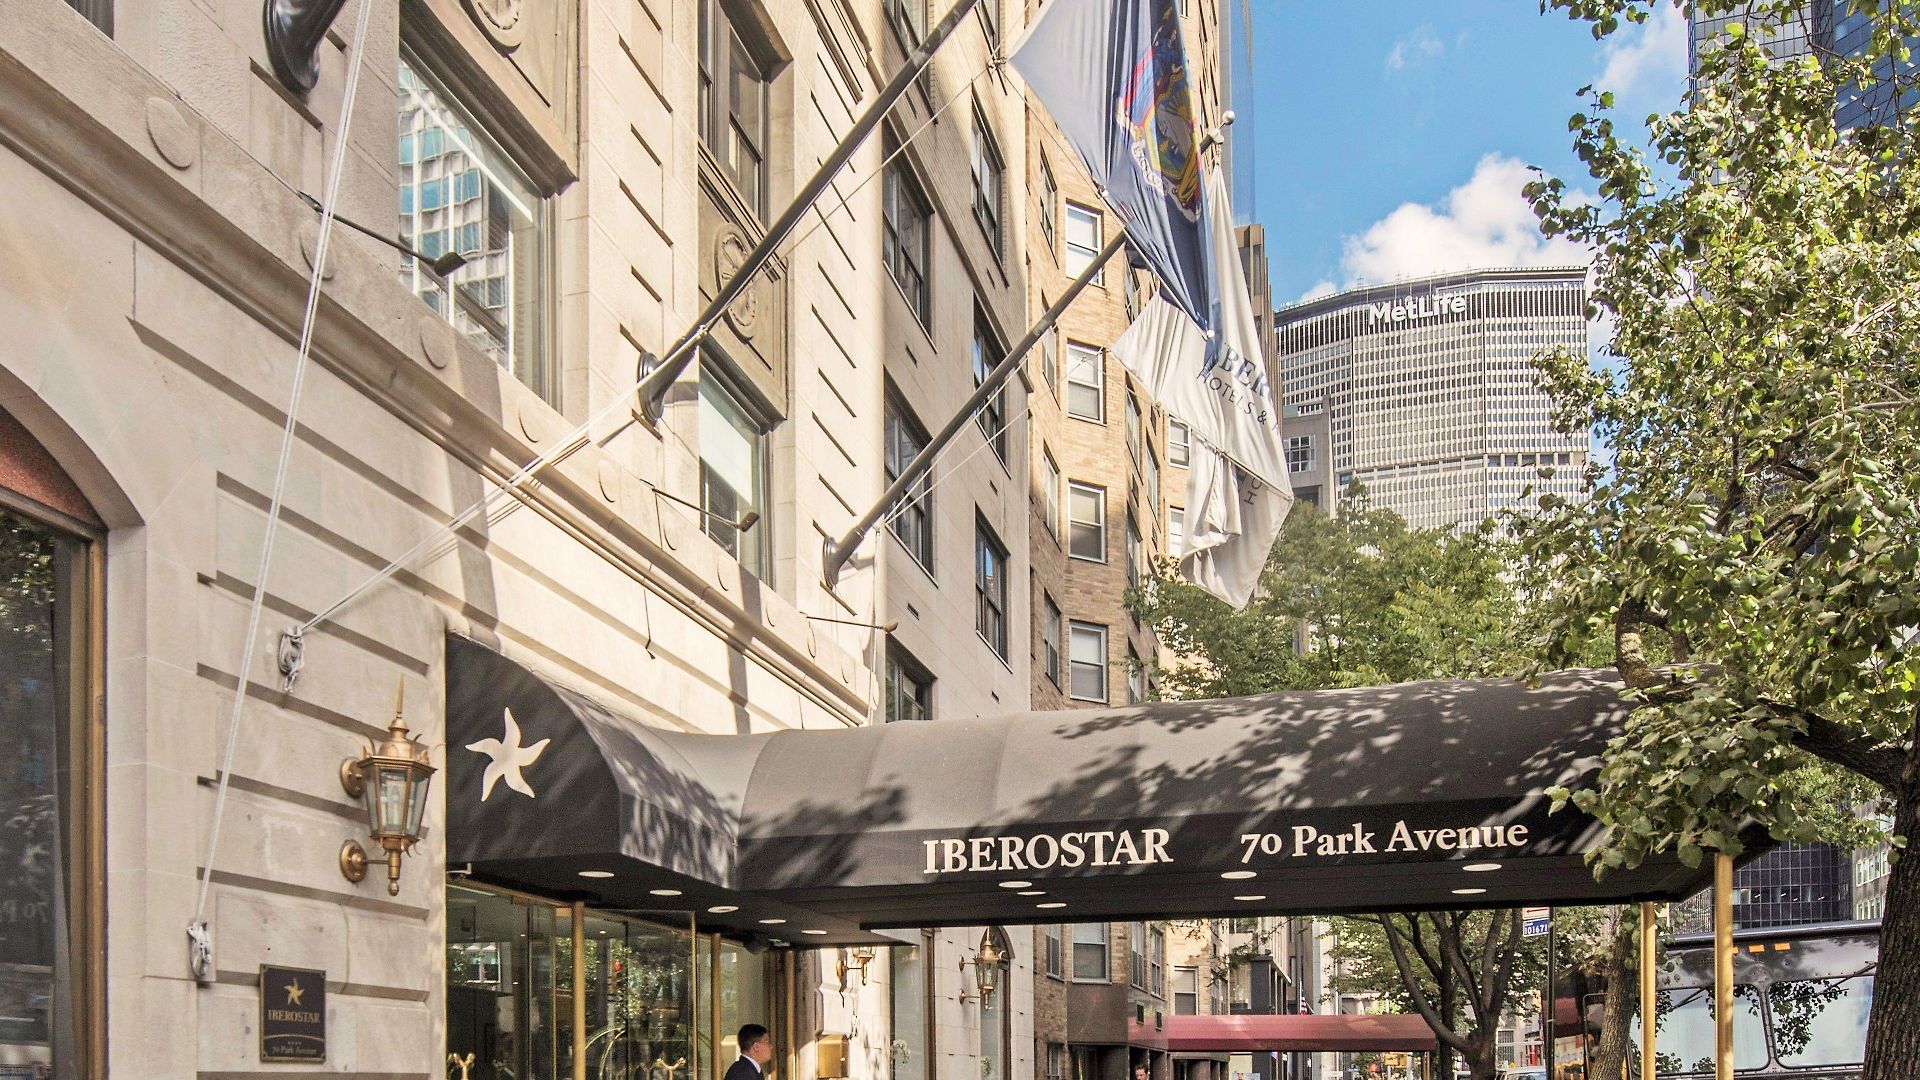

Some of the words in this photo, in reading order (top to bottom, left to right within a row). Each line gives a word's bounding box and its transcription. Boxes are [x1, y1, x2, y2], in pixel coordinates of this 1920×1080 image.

[1369, 292, 1466, 325] MetLife
[923, 828, 1174, 874] IBEROSTAR
[1240, 832, 1282, 864] 70
[1291, 822, 1377, 857] Park
[1385, 819, 1528, 853] Avenue
[268, 1009, 320, 1024] IBEROSTAR
